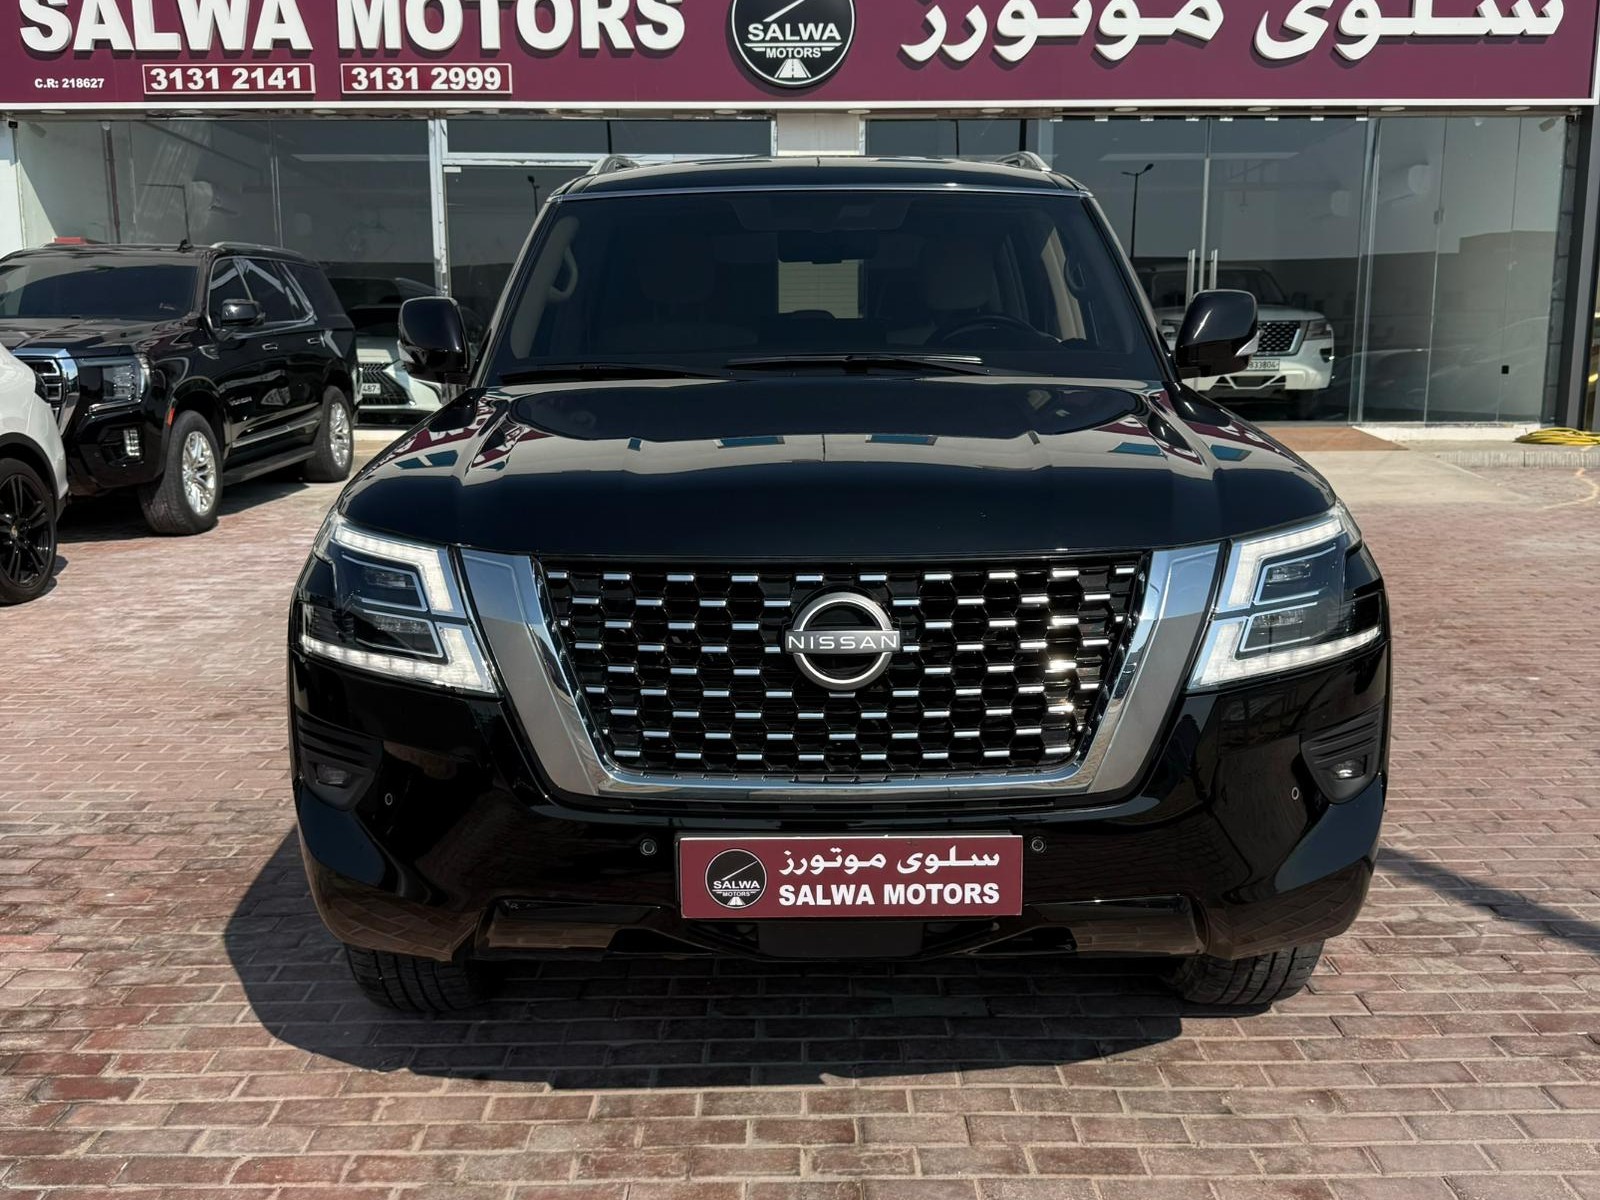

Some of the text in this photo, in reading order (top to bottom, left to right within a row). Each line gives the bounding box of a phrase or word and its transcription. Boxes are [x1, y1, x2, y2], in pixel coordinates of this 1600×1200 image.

[20, 0, 685, 52] SALWA MOTORS
[747, 22, 842, 41] SALWA
[765, 47, 822, 59] MOTORS
[34, 77, 105, 89] C.R: 218627
[150, 67, 302, 90] 3131 2141
[351, 67, 501, 91] 3131 2999
[788, 635, 898, 650] NISSAN
[779, 845, 1000, 876] سلوى موتورز
[713, 880, 761, 889] SALWA
[778, 883, 1000, 906] SALWA MOTORS
